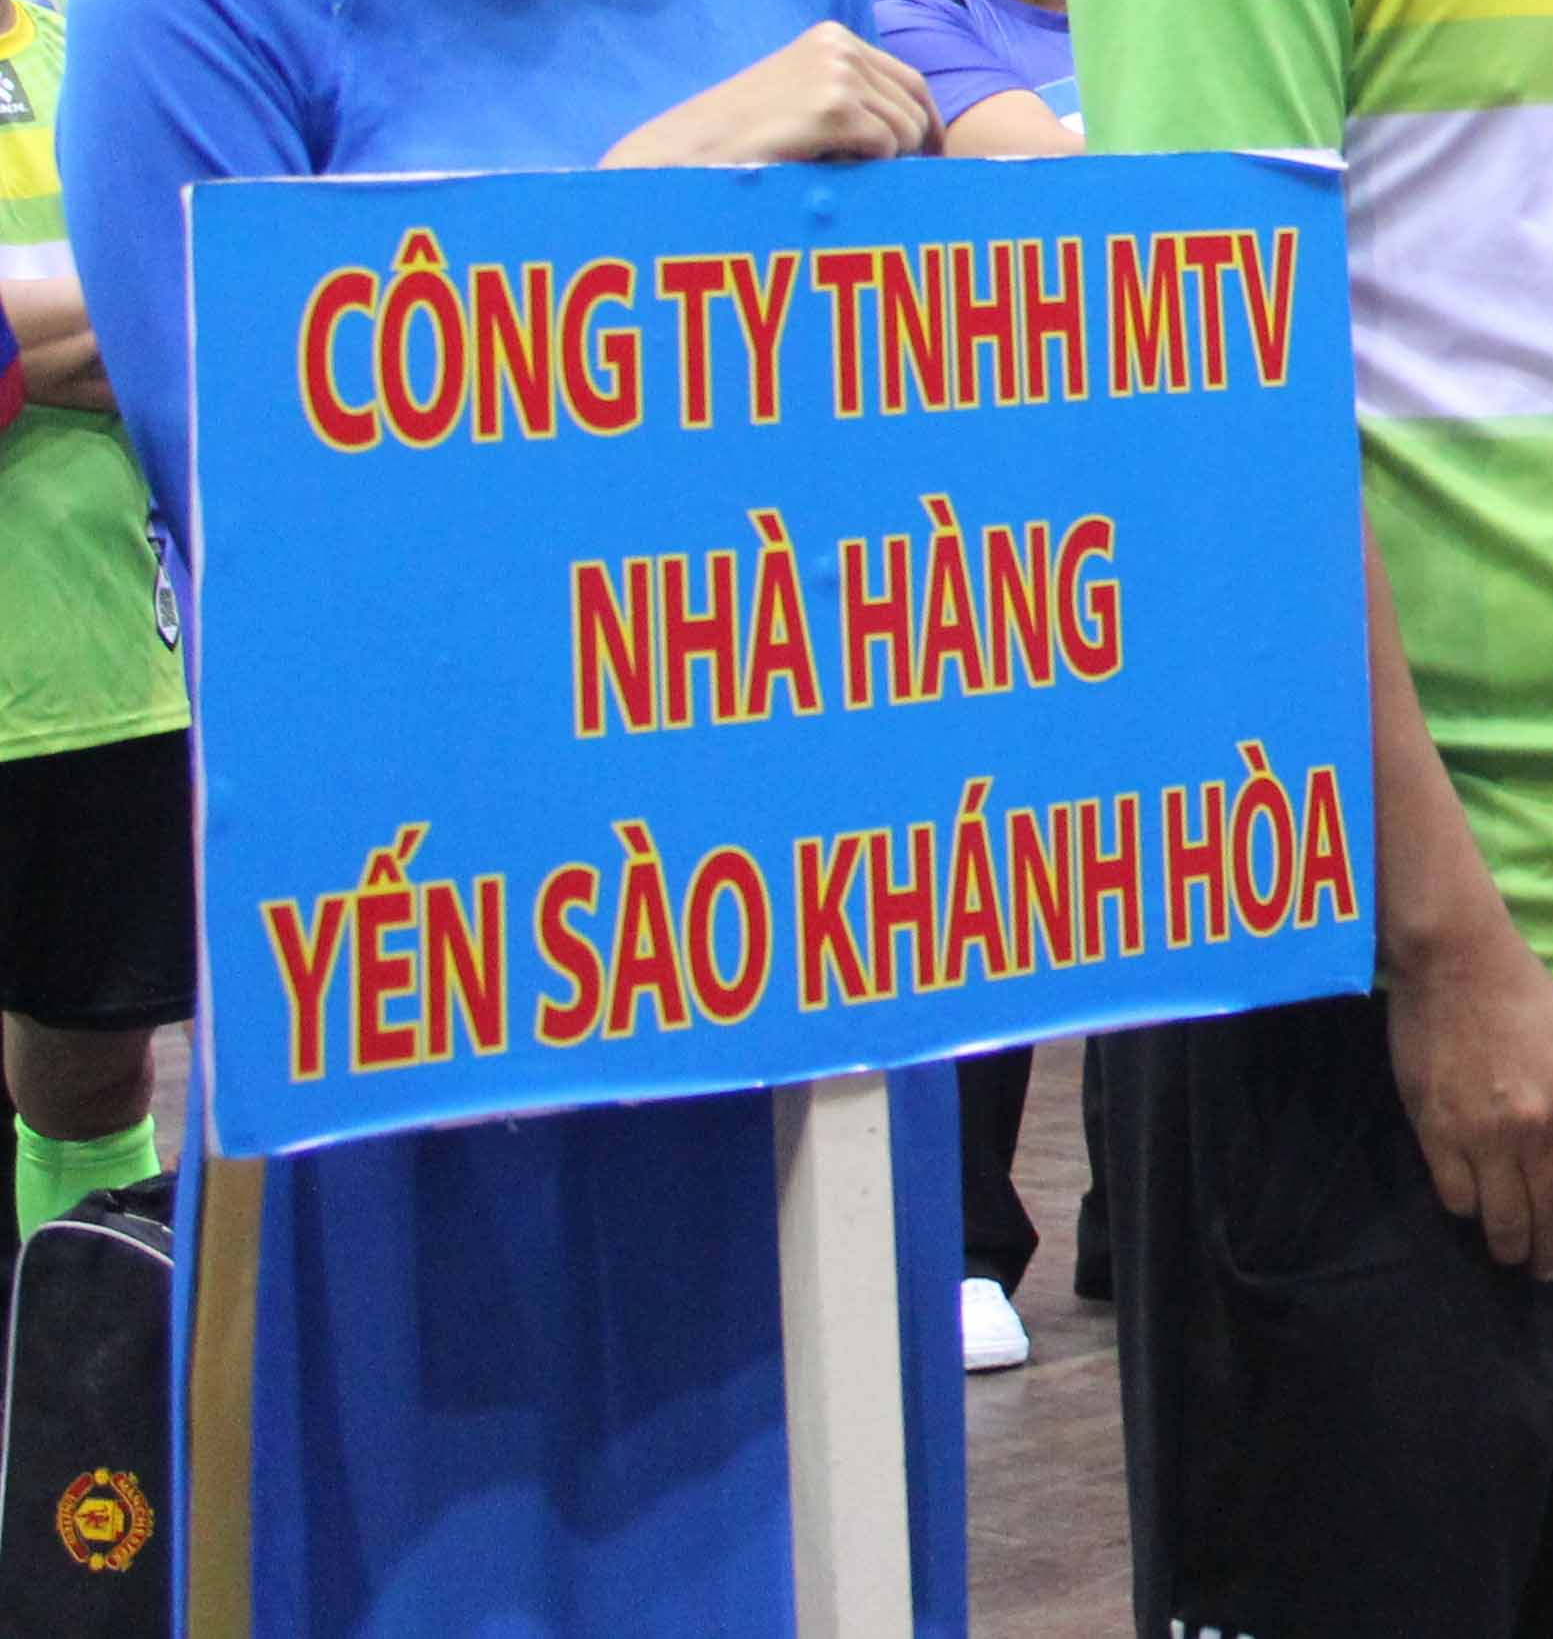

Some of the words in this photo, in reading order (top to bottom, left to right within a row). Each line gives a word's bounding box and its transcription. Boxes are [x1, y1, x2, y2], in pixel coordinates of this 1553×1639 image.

[299, 227, 643, 452] CÔNG
[655, 249, 800, 429] TY
[811, 236, 1086, 420] TNHH
[1109, 227, 1300, 396] MTV
[570, 508, 822, 738] NHÀ
[840, 493, 1122, 709] HÀNG
[262, 821, 508, 1083] YẾN
[535, 818, 772, 1047] SÀO
[795, 776, 1142, 1013] KHÁNH
[1163, 740, 1361, 946] HÒA
